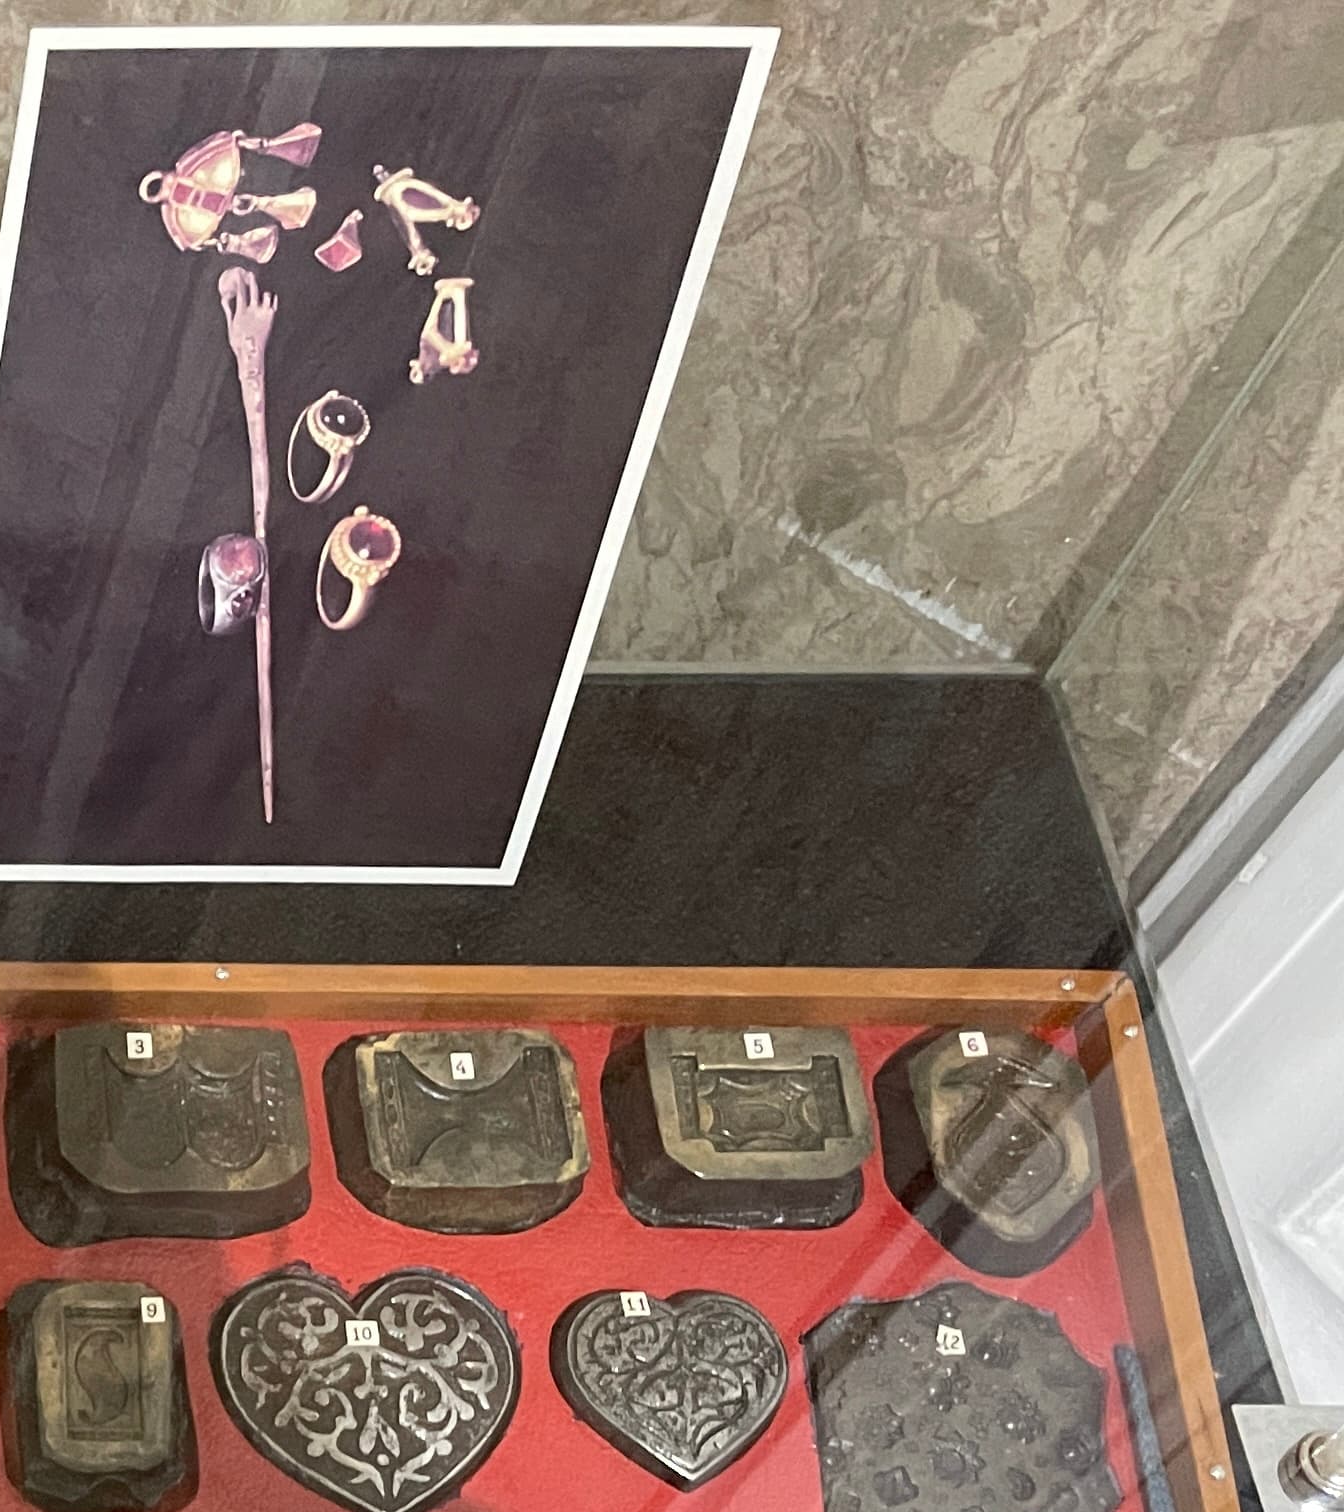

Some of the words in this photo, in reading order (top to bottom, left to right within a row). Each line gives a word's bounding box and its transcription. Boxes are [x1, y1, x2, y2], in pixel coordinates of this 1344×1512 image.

[134, 1039, 145, 1055] 3
[753, 1039, 764, 1054] 5
[967, 1037, 979, 1052] 6
[455, 1060, 466, 1075] 4
[146, 1302, 158, 1319] 9
[627, 1297, 646, 1311] 11
[353, 1326, 372, 1342] 10
